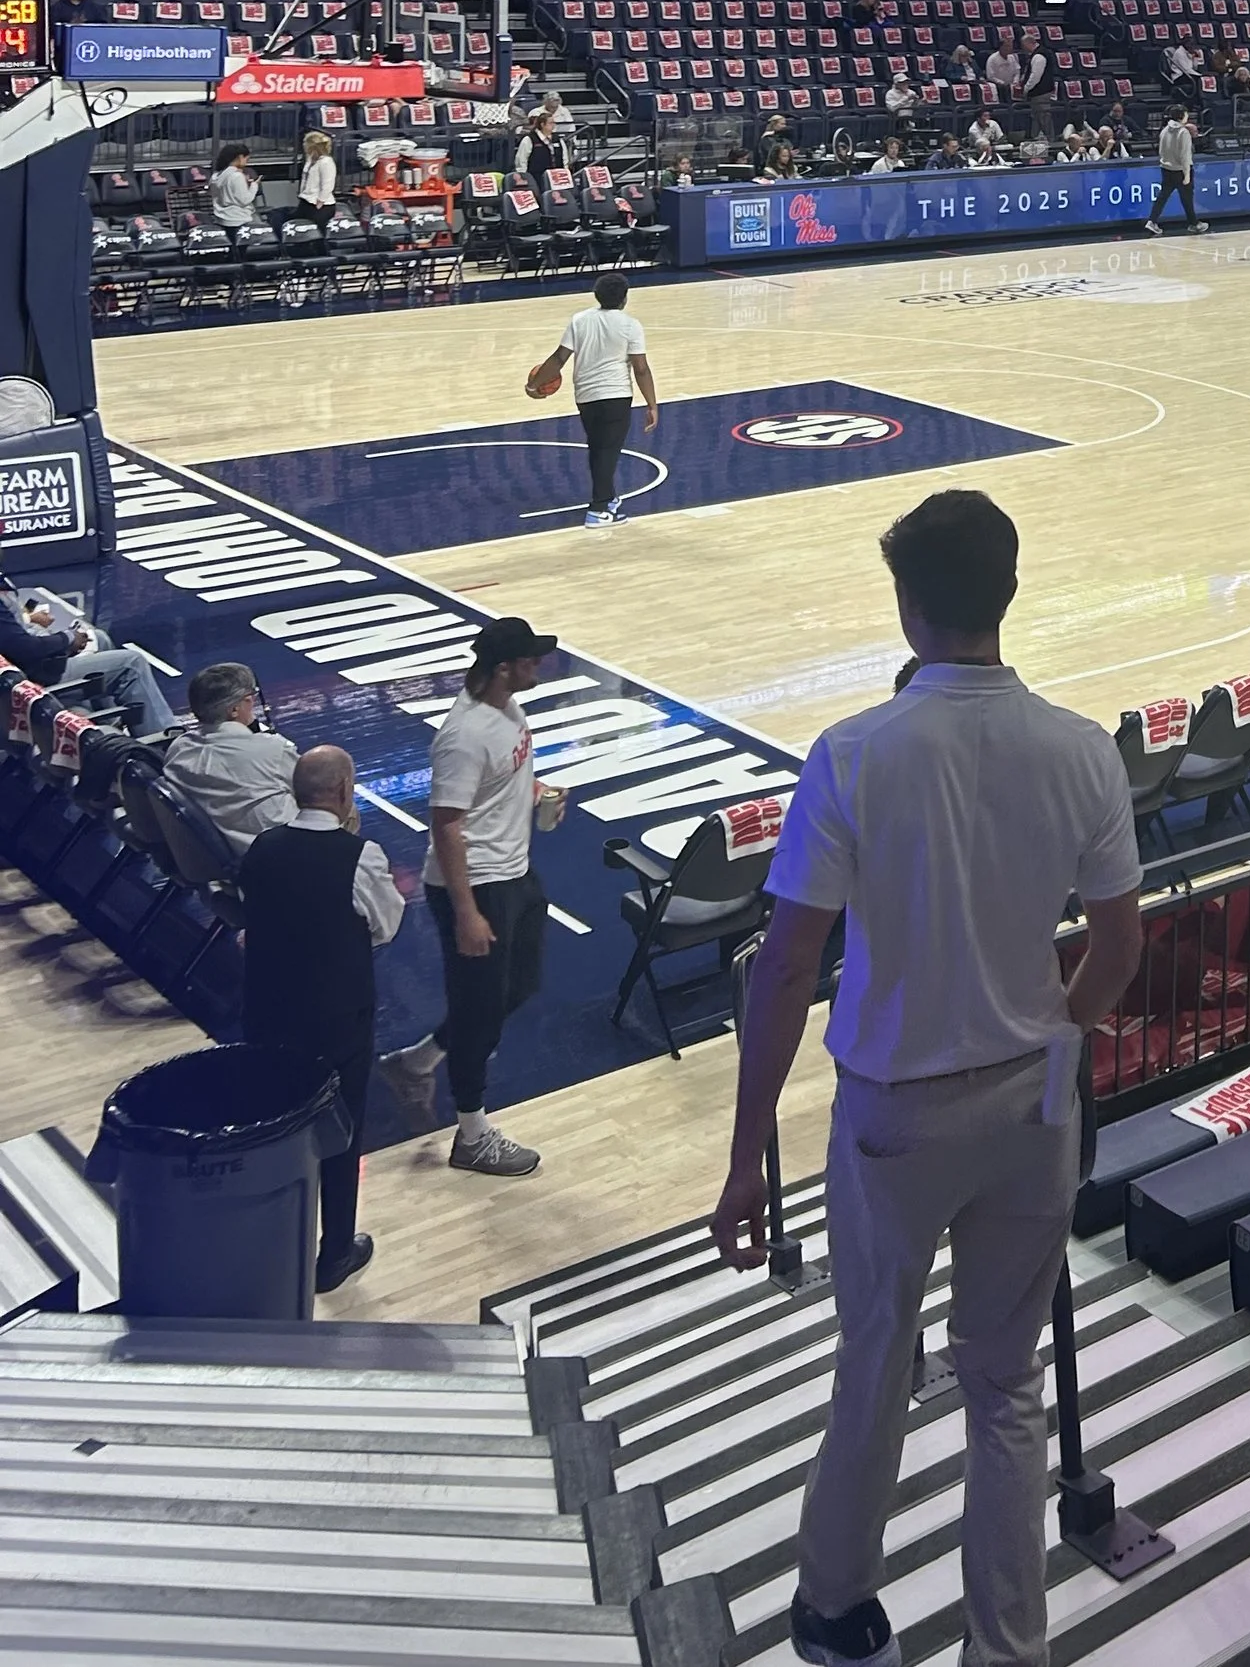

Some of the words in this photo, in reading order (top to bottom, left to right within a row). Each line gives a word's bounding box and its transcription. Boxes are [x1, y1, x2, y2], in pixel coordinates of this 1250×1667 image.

[107, 45, 212, 61] Higginbotham
[734, 204, 766, 218] BUILT
[789, 193, 816, 220] Ole
[918, 197, 976, 219] THE
[998, 190, 1069, 214] 2025
[735, 231, 766, 243] TOUGH
[795, 218, 837, 244] Miss
[899, 277, 1096, 305] CRADDOCK
[959, 286, 1088, 306] COURT
[0, 466, 68, 492] FARM
